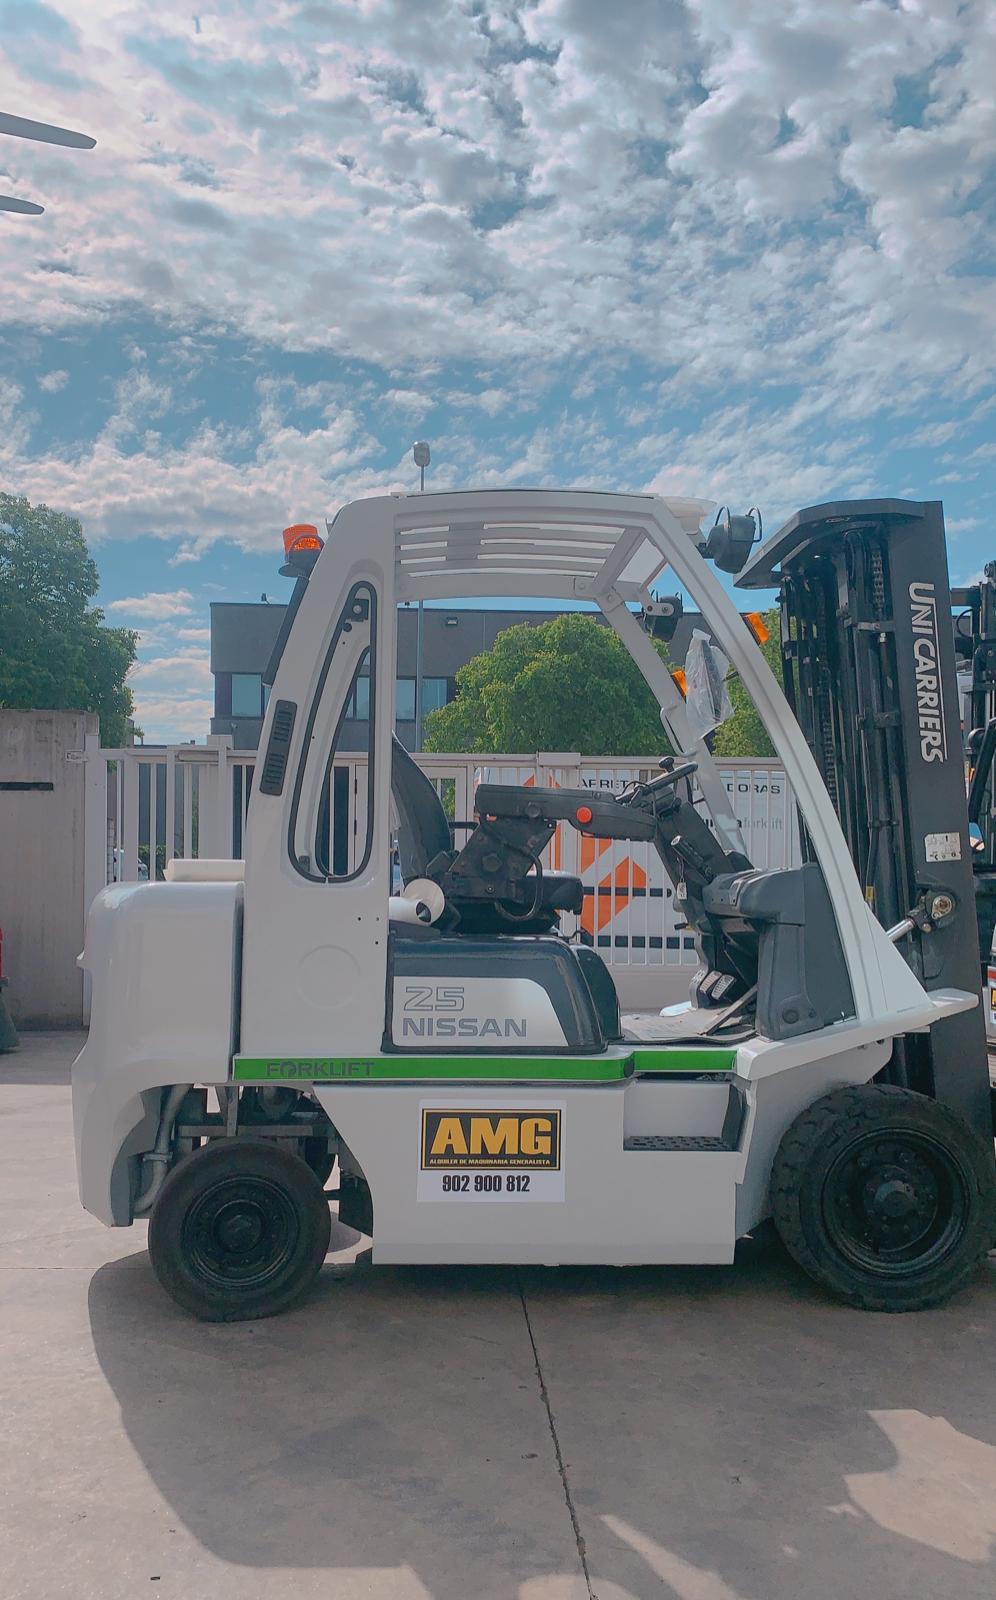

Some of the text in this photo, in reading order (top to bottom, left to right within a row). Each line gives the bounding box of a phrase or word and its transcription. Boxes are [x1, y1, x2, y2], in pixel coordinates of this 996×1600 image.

[403, 986, 465, 1012] 25
[402, 1018, 527, 1037] NISSAN
[265, 1061, 375, 1078] FORKLIFT
[430, 1117, 552, 1155] AMG
[442, 1174, 531, 1192] 902 900 812
